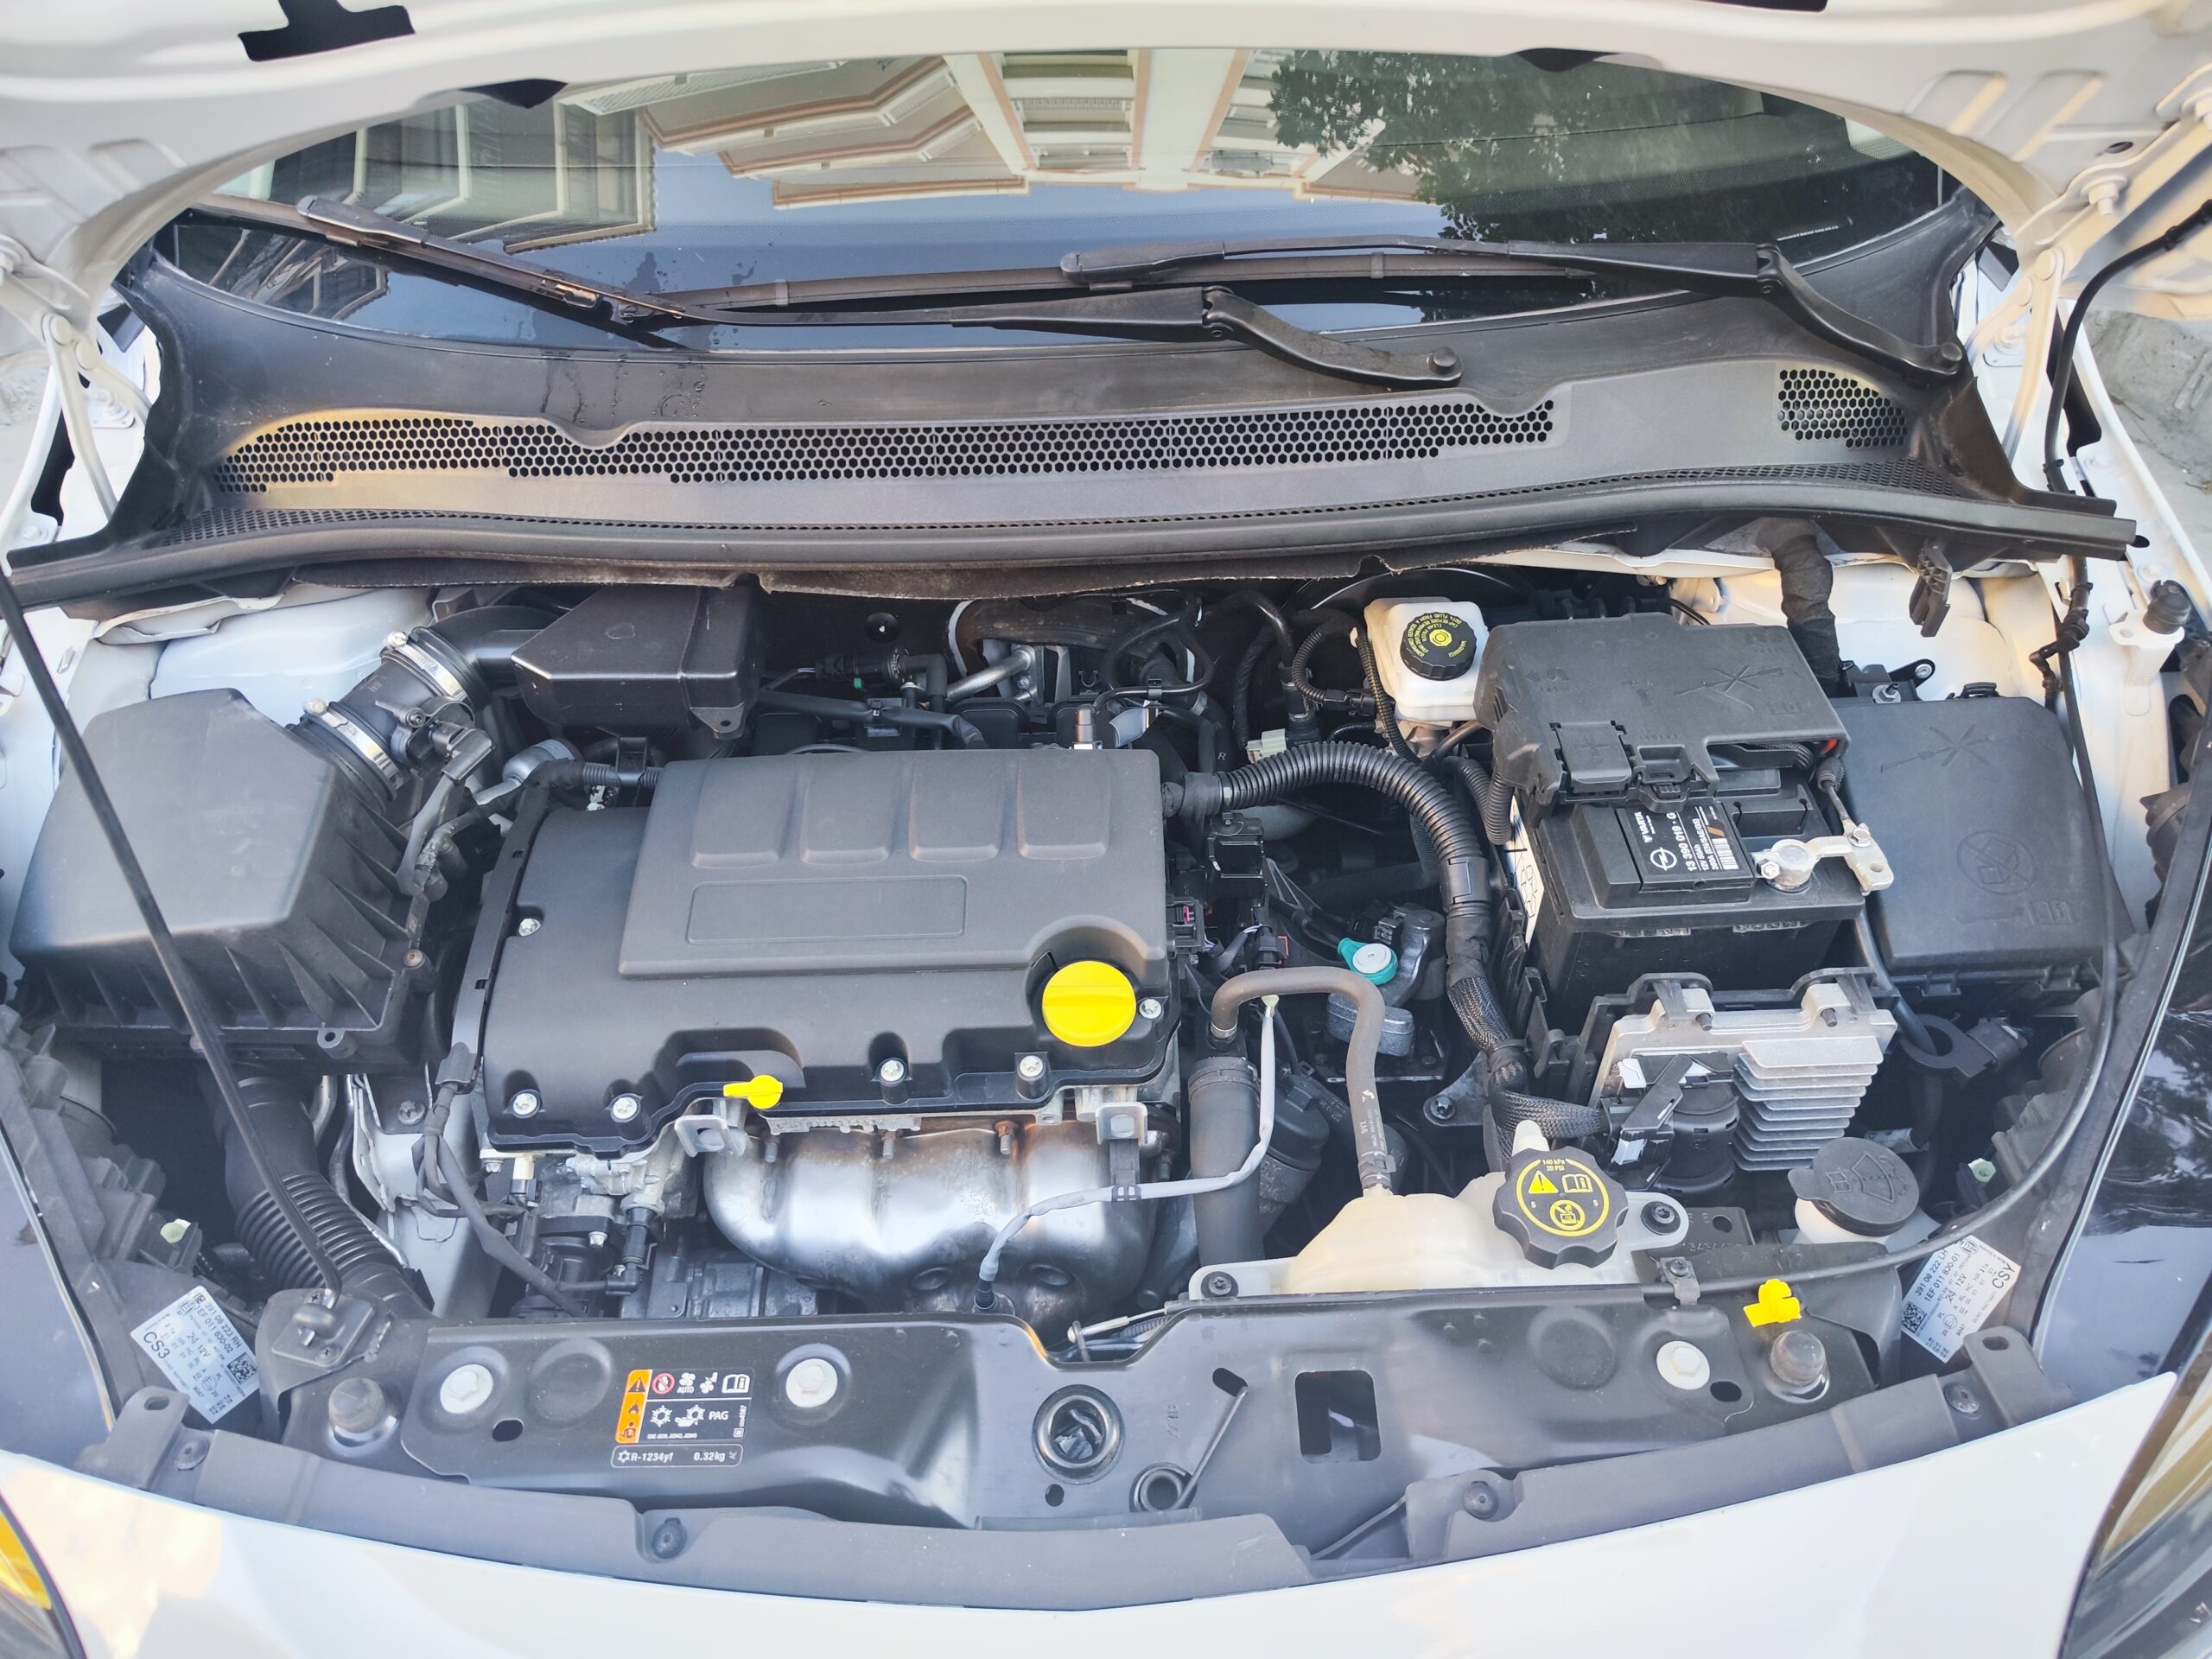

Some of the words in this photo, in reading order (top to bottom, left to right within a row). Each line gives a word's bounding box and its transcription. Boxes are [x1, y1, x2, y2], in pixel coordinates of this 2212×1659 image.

[1635, 811, 1649, 836] VARTA
[1671, 826, 1685, 842] 019
[1678, 843, 1693, 859] 390
[1686, 861, 1697, 871] 13
[1915, 1283, 1926, 1296] 391
[1923, 1274, 1932, 1282] 08
[1929, 1260, 1941, 1274] 222
[1938, 1249, 1948, 1260] LH
[1992, 1261, 2015, 1289] CSY
[1924, 1287, 1935, 1301] 1EF
[1933, 1275, 1944, 1288] 011
[1945, 1290, 1956, 1302] 24
[1955, 1274, 1967, 1287] 12V
[205, 1303, 217, 1315] 391
[214, 1315, 224, 1325] 08
[221, 1324, 233, 1337] 223
[232, 1336, 242, 1348] RH
[205, 1318, 217, 1331] 011
[214, 1331, 234, 1354] 830-02
[143, 1332, 170, 1359] CS3
[197, 1344, 210, 1357] 12V
[709, 1410, 729, 1421] PAG
[631, 1452, 674, 1462] R-1234yf
[694, 1452, 726, 1462] 0.32kg
